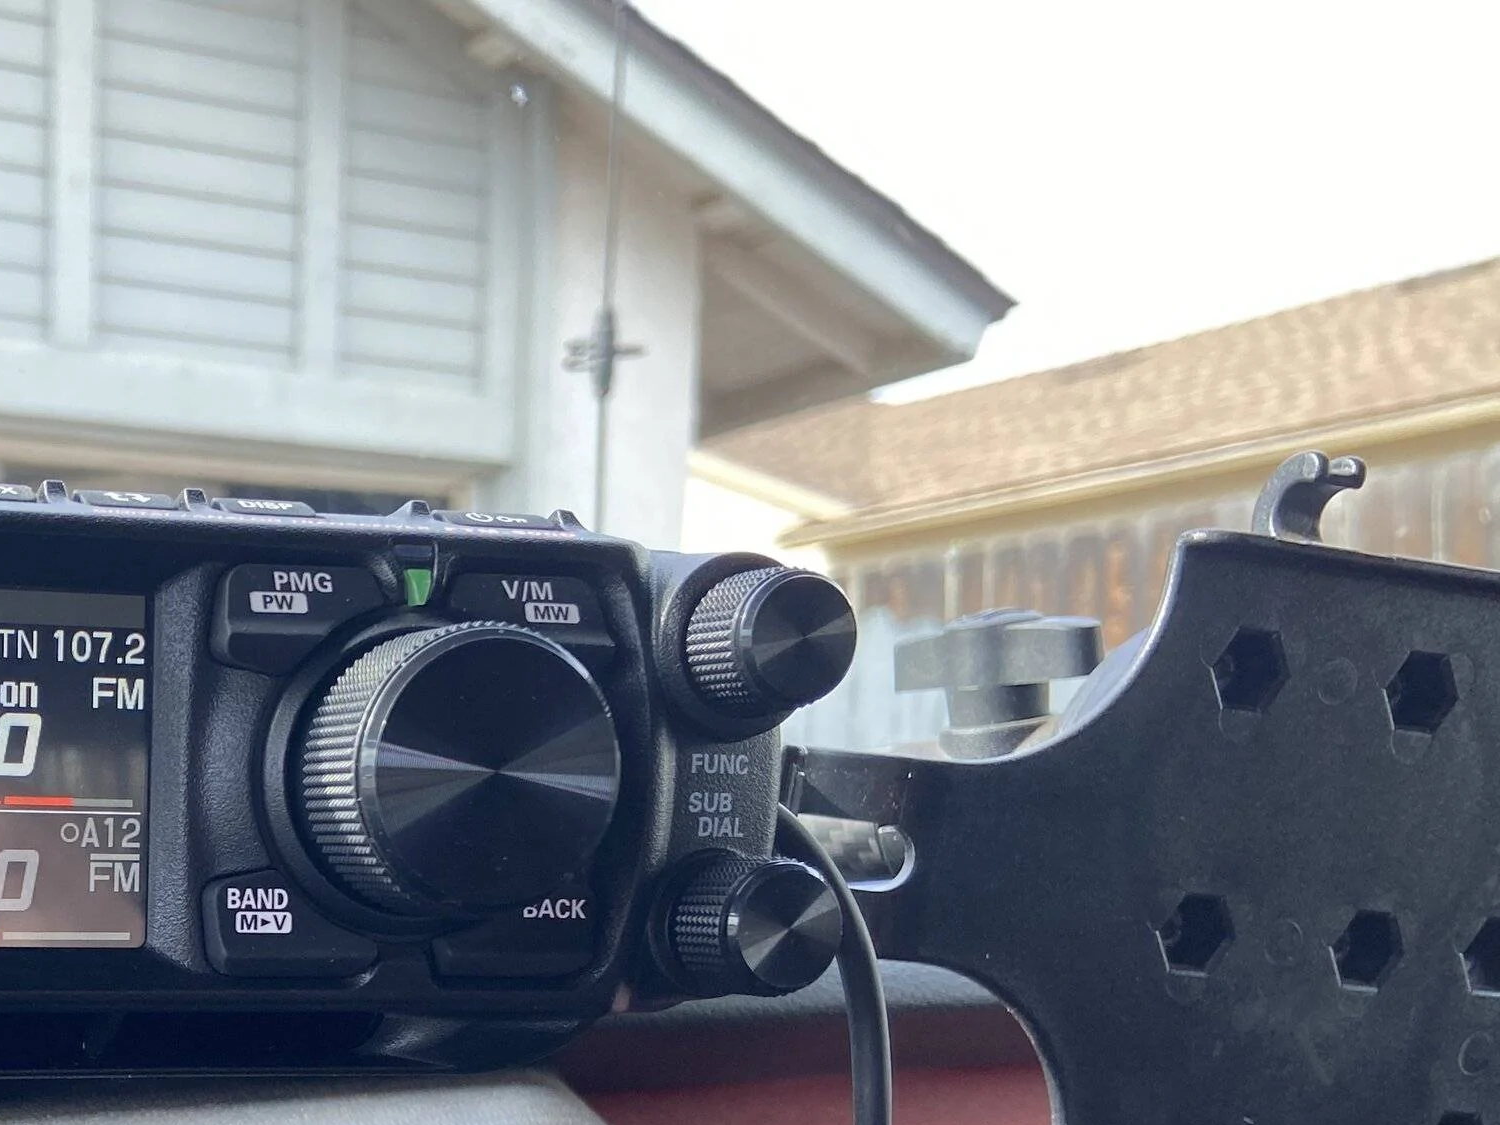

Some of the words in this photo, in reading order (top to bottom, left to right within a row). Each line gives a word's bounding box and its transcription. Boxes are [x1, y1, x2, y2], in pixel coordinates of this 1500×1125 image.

[273, 572, 332, 595] PMG
[502, 580, 553, 603] V/M
[262, 595, 293, 610] PW
[533, 605, 572, 624] MW
[54, 630, 145, 664] 107.2
[93, 677, 144, 709] FM
[691, 753, 750, 777] FUNC
[689, 792, 734, 815] SUB
[698, 816, 746, 840] DIAL
[89, 862, 139, 895] FM
[228, 888, 288, 909] BAND
